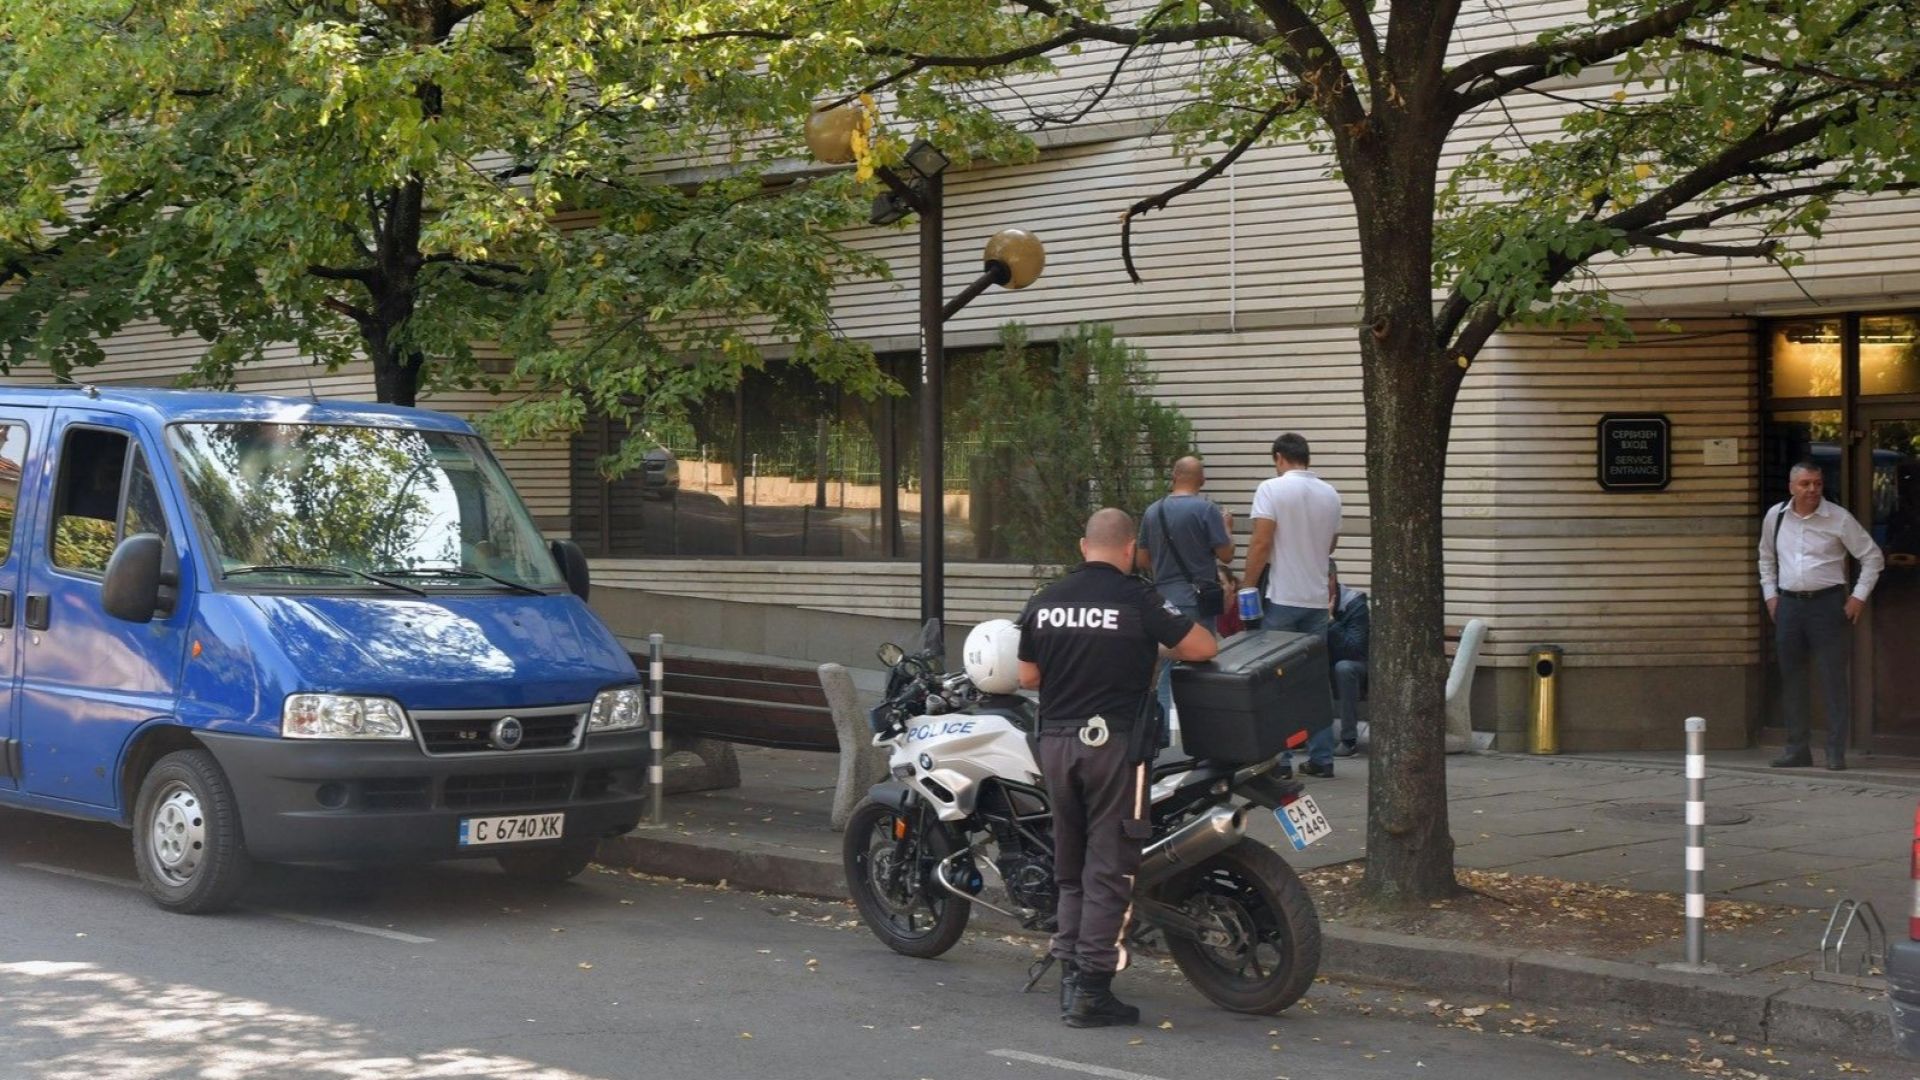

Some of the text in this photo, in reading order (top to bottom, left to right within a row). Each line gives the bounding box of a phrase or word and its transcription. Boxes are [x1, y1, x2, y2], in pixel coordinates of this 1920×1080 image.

[1611, 430, 1658, 440] СЕРВИЗЕН
[1621, 440, 1648, 449] ВХОД
[1615, 455, 1654, 465] SERVICE
[1609, 465, 1660, 475] ENTRANCE
[1037, 607, 1120, 630] POLICE
[906, 721, 977, 743] POLICE
[476, 816, 561, 842] C 6740 XK
[1297, 815, 1328, 841] 7449
